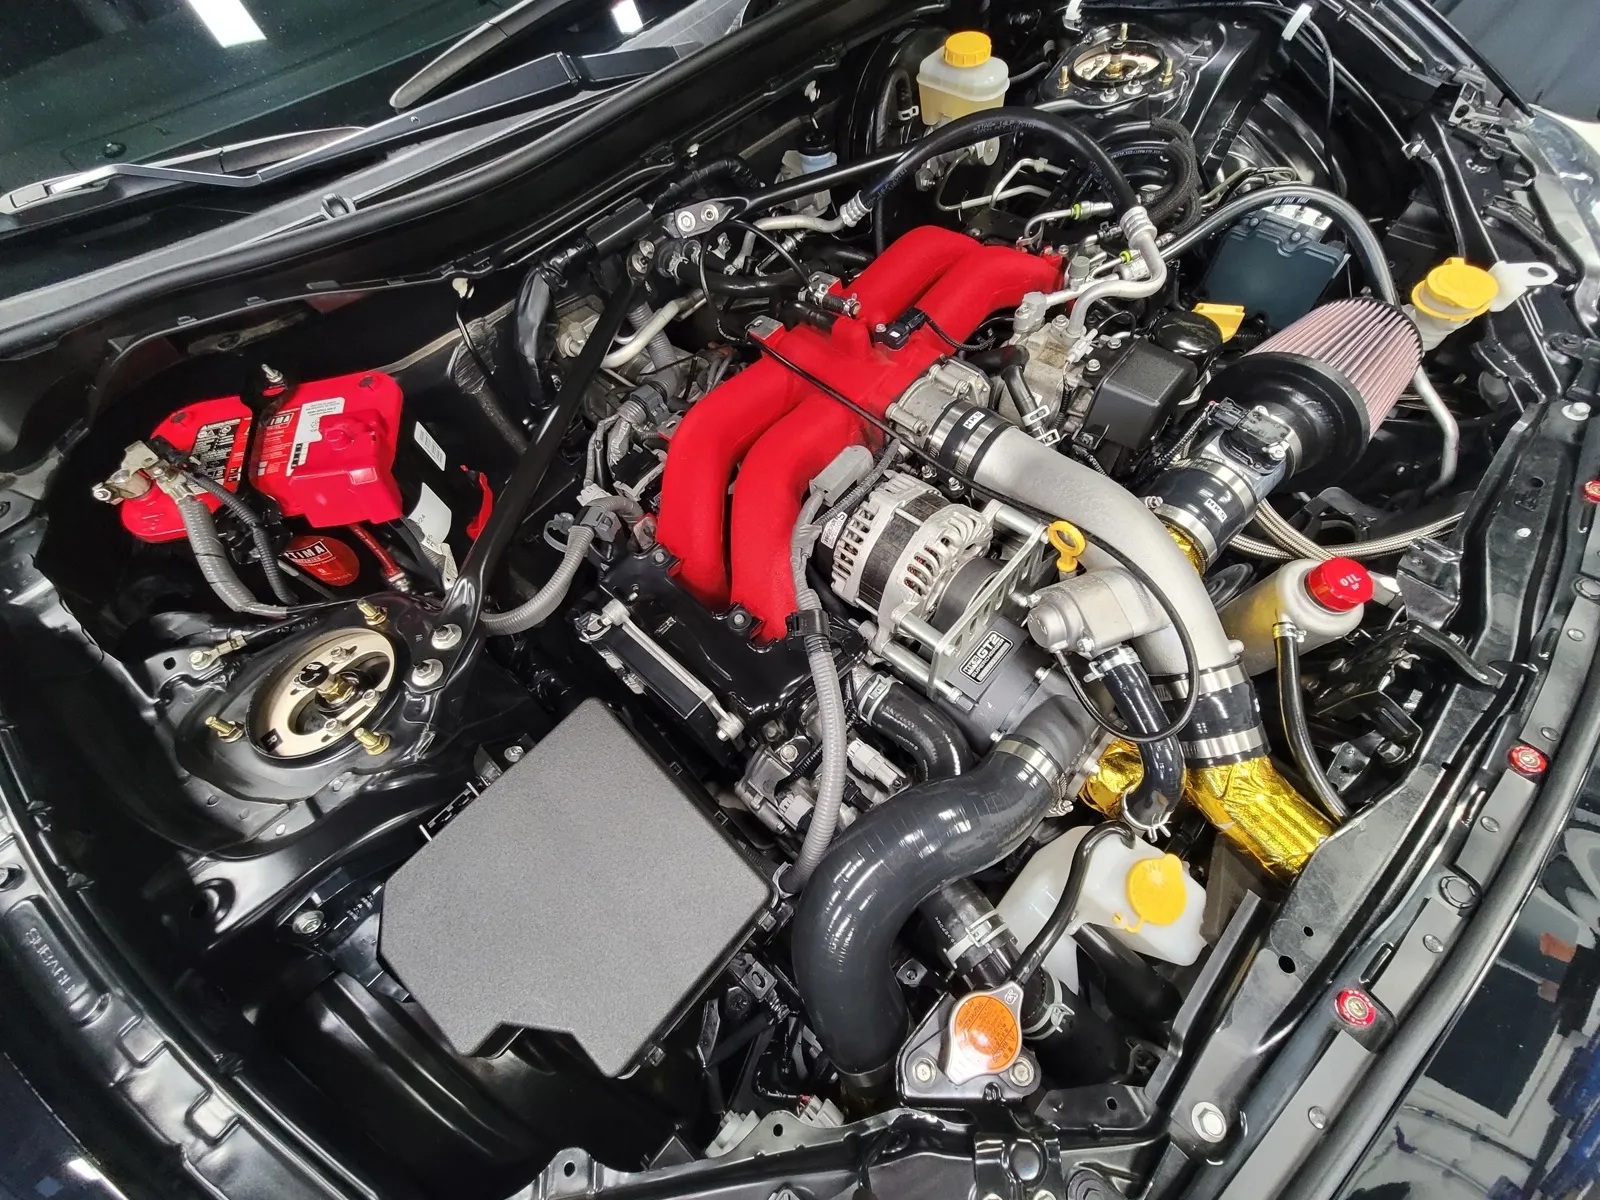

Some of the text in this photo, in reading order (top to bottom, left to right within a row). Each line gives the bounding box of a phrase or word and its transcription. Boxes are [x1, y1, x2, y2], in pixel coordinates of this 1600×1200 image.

[964, 412, 983, 428] HKS
[1206, 499, 1226, 521] HKS
[1340, 574, 1361, 587] OIL
[964, 633, 1001, 673] HKS GT2
[267, 735, 278, 745] R
[26, 927, 76, 994] SUBARU
